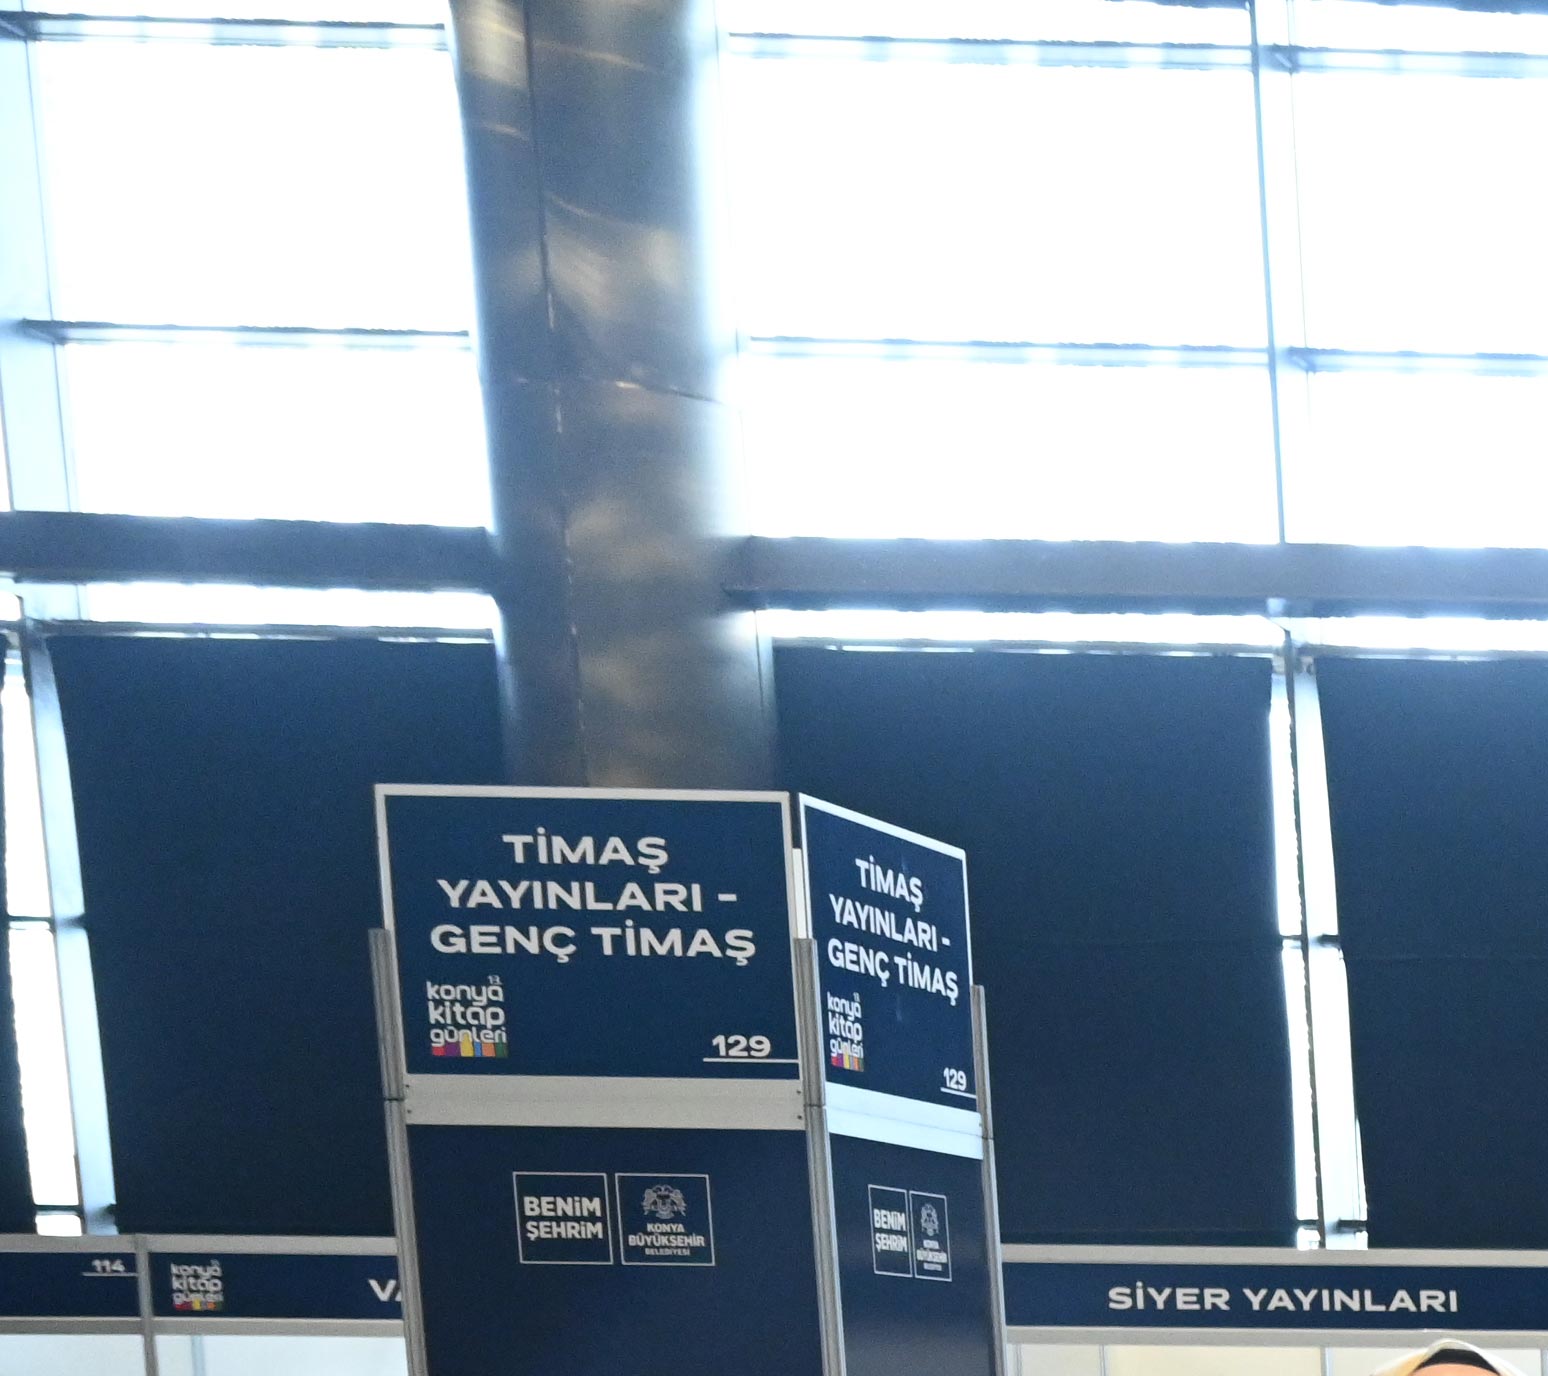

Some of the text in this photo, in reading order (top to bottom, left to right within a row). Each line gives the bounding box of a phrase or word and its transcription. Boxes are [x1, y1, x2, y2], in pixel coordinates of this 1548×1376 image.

[503, 827, 668, 873] TİMAŞ
[437, 878, 702, 912] YAYINLARI
[855, 855, 924, 908] TİMAŞ
[829, 893, 937, 952] YAYINLARI
[430, 919, 757, 967] GENÇ TİMAŞ
[827, 940, 959, 1006] GENÇ TİMAŞ
[426, 980, 504, 1006] konya
[827, 991, 862, 1021] konya
[428, 1001, 506, 1030] kitap
[828, 1012, 863, 1042] kitap
[430, 1026, 507, 1047] günleri
[711, 1035, 771, 1057] 129
[943, 1067, 968, 1091] 129
[523, 1196, 602, 1217] BENİM
[526, 1221, 603, 1241] ŞEHRİM
[628, 1232, 705, 1247] BÜYÜKŞEHİR
[647, 1223, 685, 1233] KONYA
[91, 1259, 126, 1273] 114
[1108, 1281, 1458, 1313] SİYER YAYINLARI
